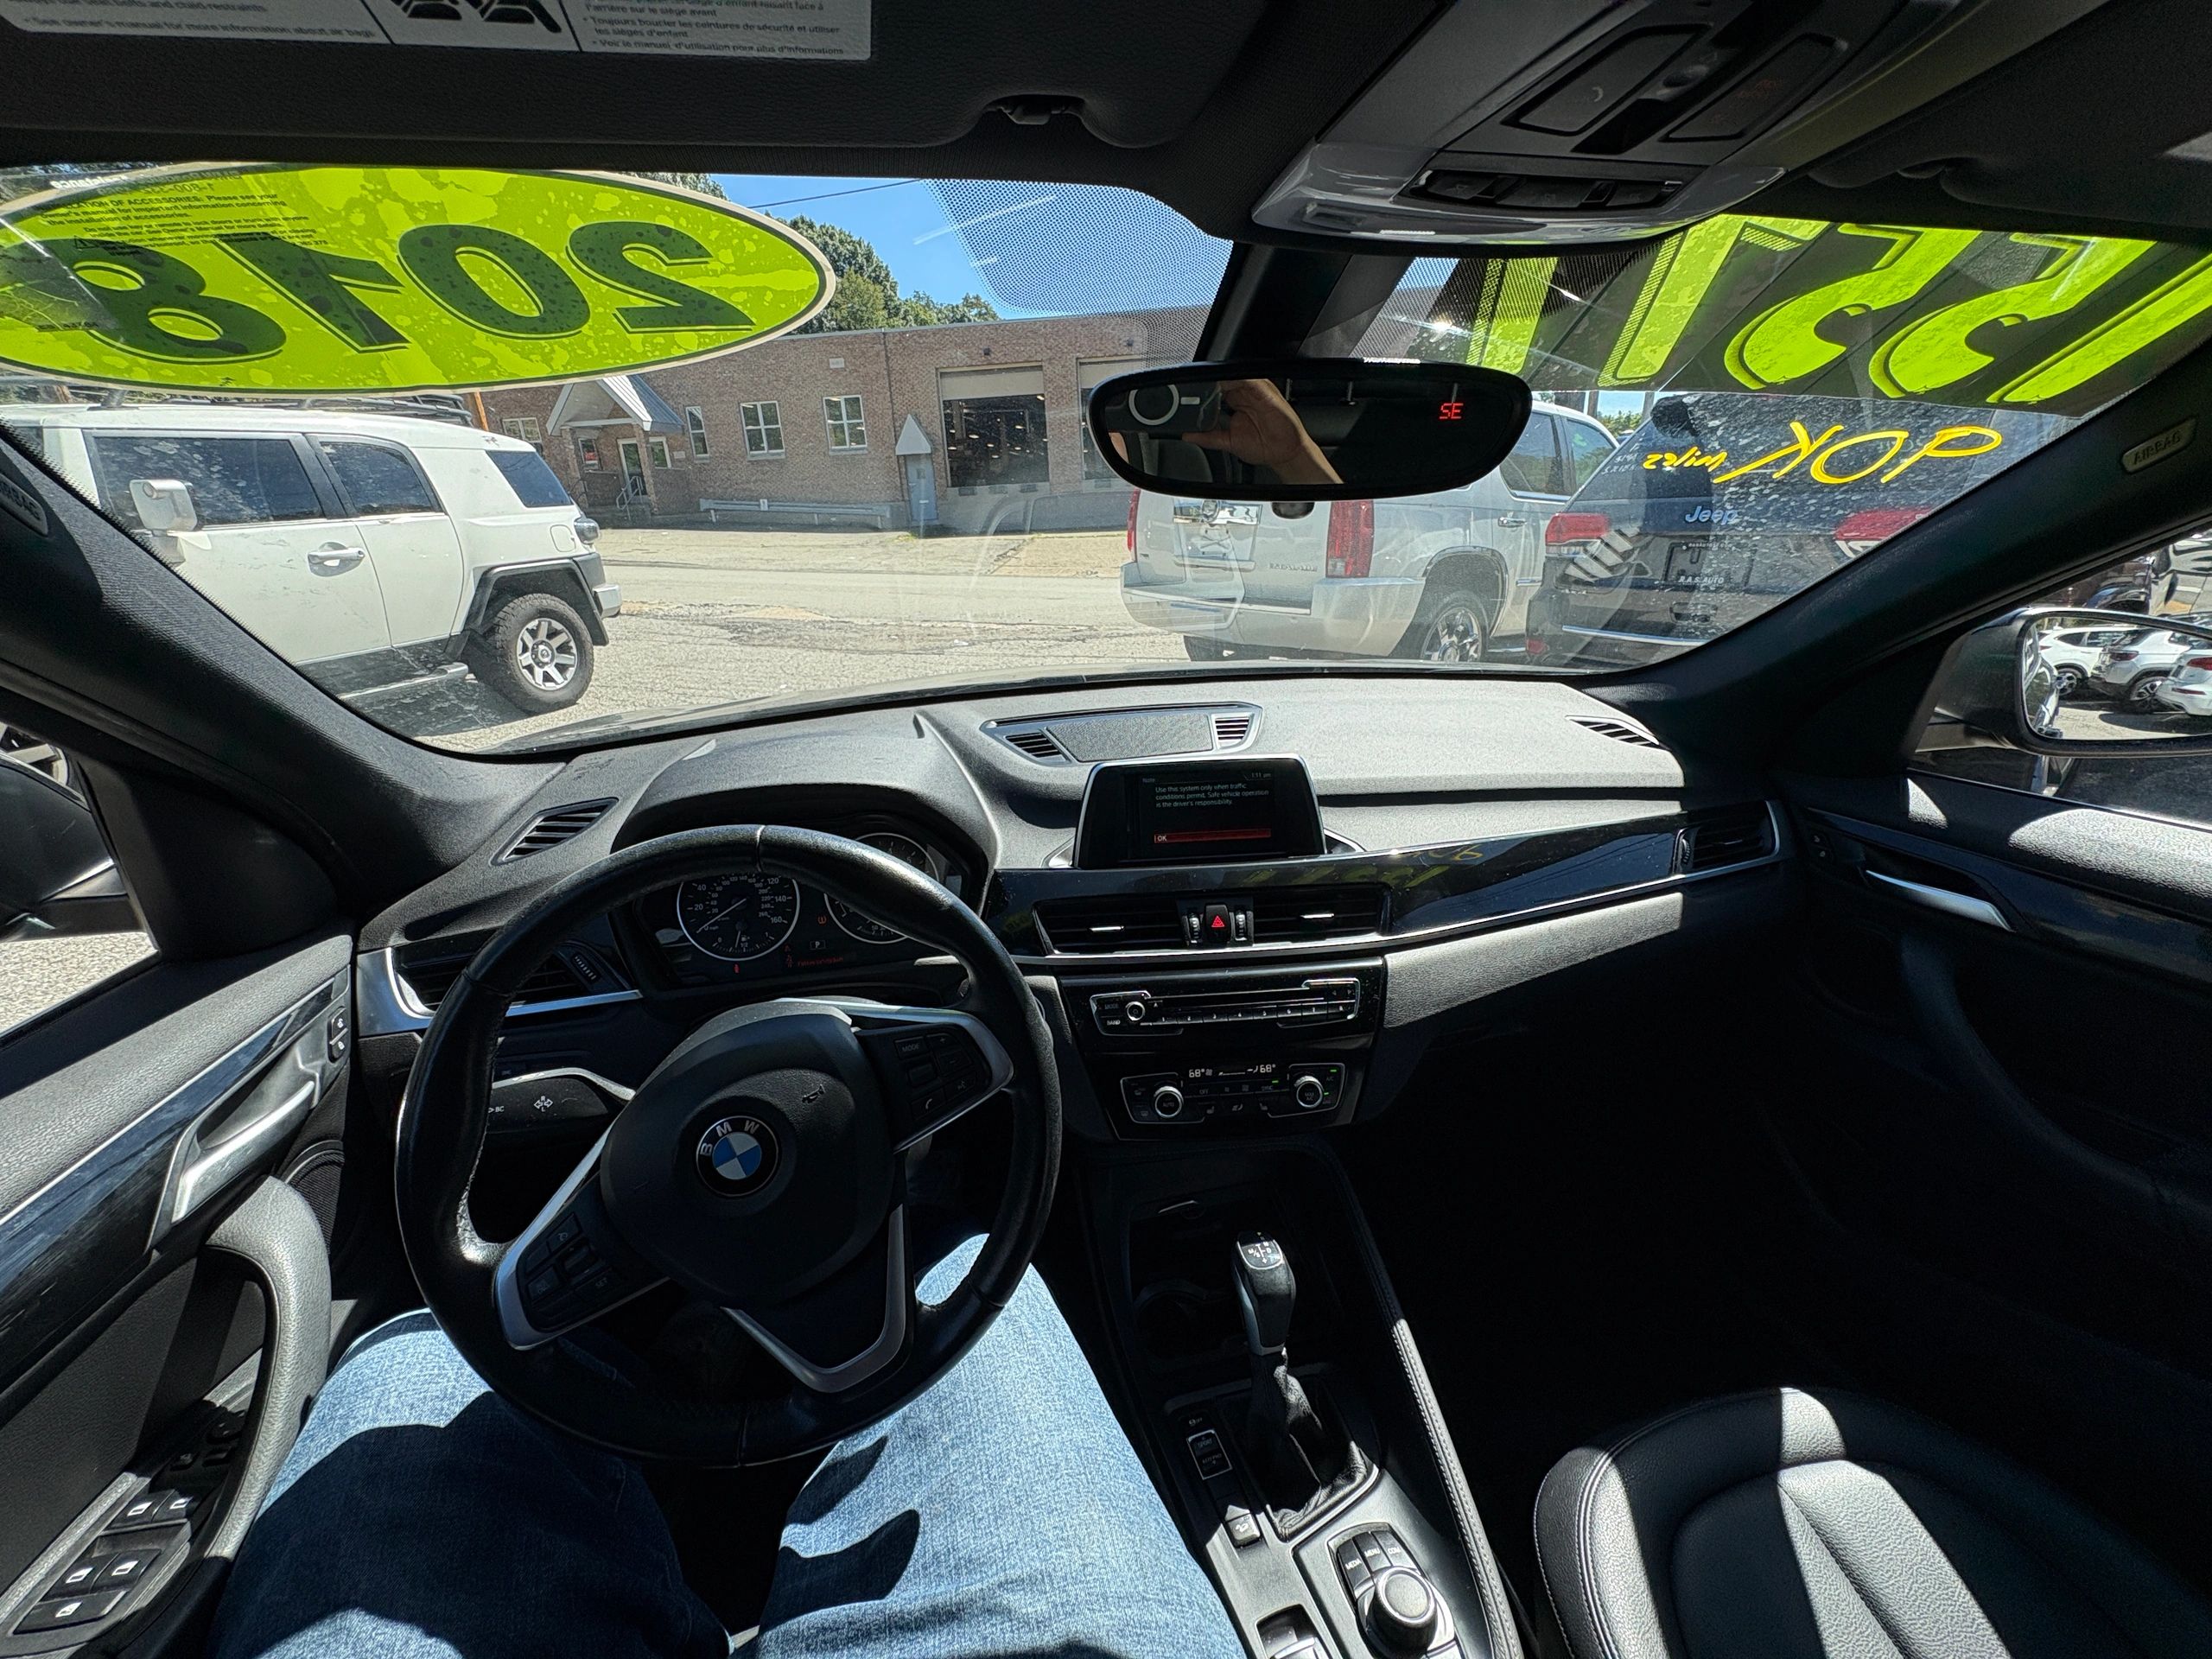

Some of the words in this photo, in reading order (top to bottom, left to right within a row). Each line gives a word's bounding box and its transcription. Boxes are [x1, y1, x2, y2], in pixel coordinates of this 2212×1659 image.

[591, 16, 637, 26] Toujours
[1685, 505, 1739, 526] Jeep
[1179, 784, 1199, 794] system
[1173, 799, 1193, 808] driver's
[766, 877, 779, 886] 120
[697, 883, 707, 892] 40
[774, 894, 787, 903] 140
[694, 904, 704, 912] 20
[770, 916, 783, 925] 160
[901, 1043, 920, 1052] MODE
[494, 1105, 505, 1114] BC
[700, 1120, 760, 1157] BMW
[1363, 1547, 1381, 1558] MENU
[1344, 1557, 1363, 1571] MEDIA
